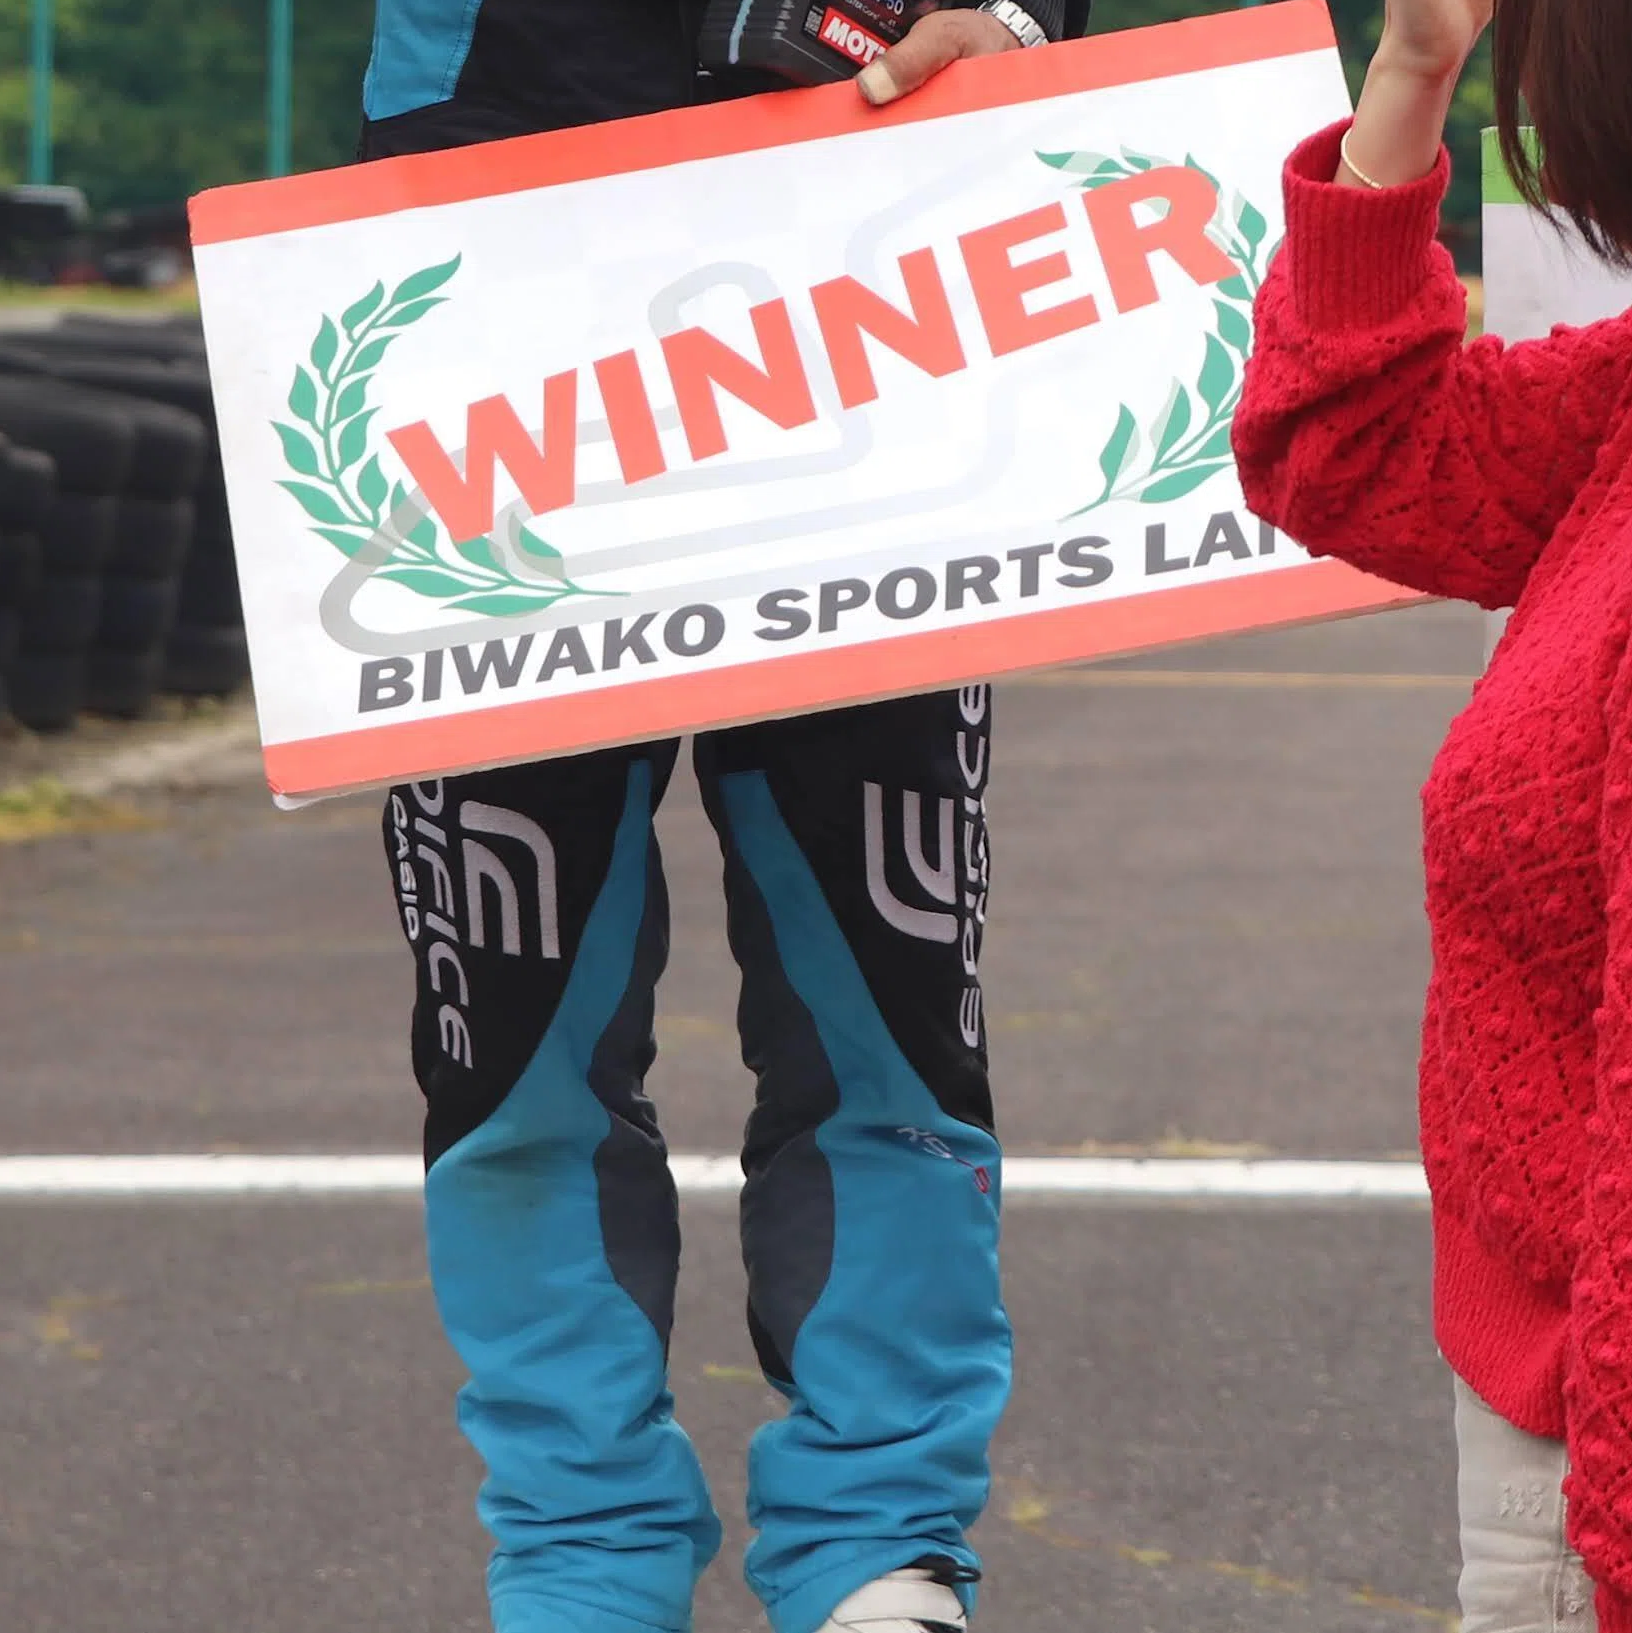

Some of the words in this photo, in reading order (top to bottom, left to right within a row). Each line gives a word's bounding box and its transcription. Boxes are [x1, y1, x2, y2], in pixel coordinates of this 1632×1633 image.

[824, 16, 887, 64] MOT
[385, 164, 1242, 546] WINNER
[357, 602, 727, 715] BIWAKO
[754, 534, 1115, 643] SPORTS
